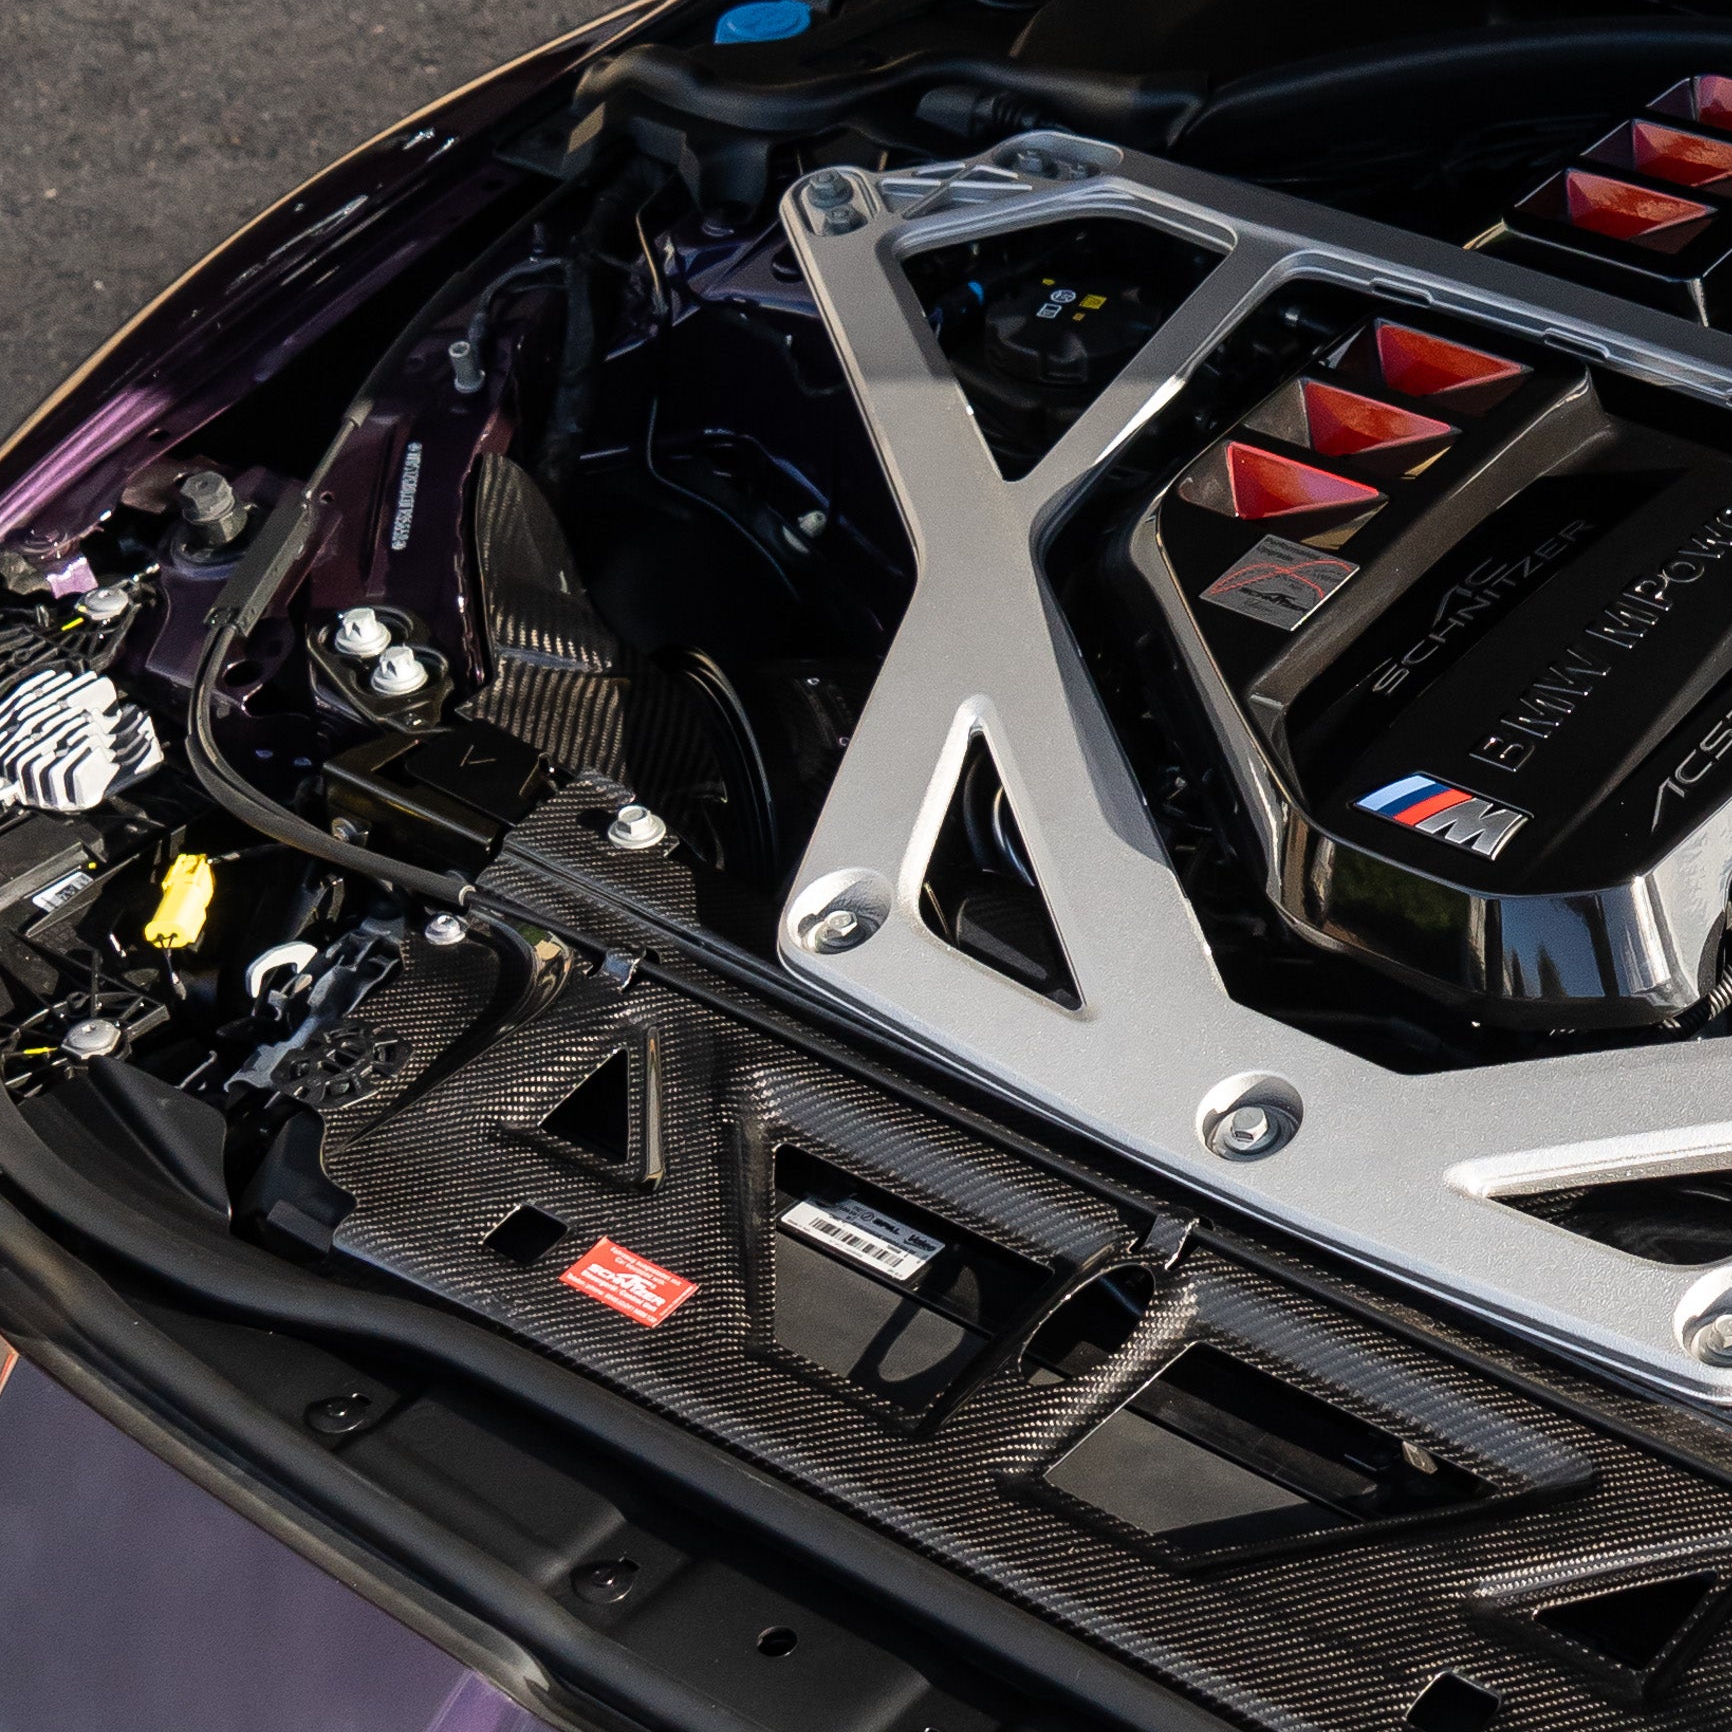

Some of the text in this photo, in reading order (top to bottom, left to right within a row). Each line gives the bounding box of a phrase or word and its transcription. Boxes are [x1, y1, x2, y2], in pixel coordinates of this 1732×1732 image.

[1371, 517, 1598, 698] SCHNITZER
[1432, 556, 1507, 629] AC
[1468, 647, 1613, 773] BMW
